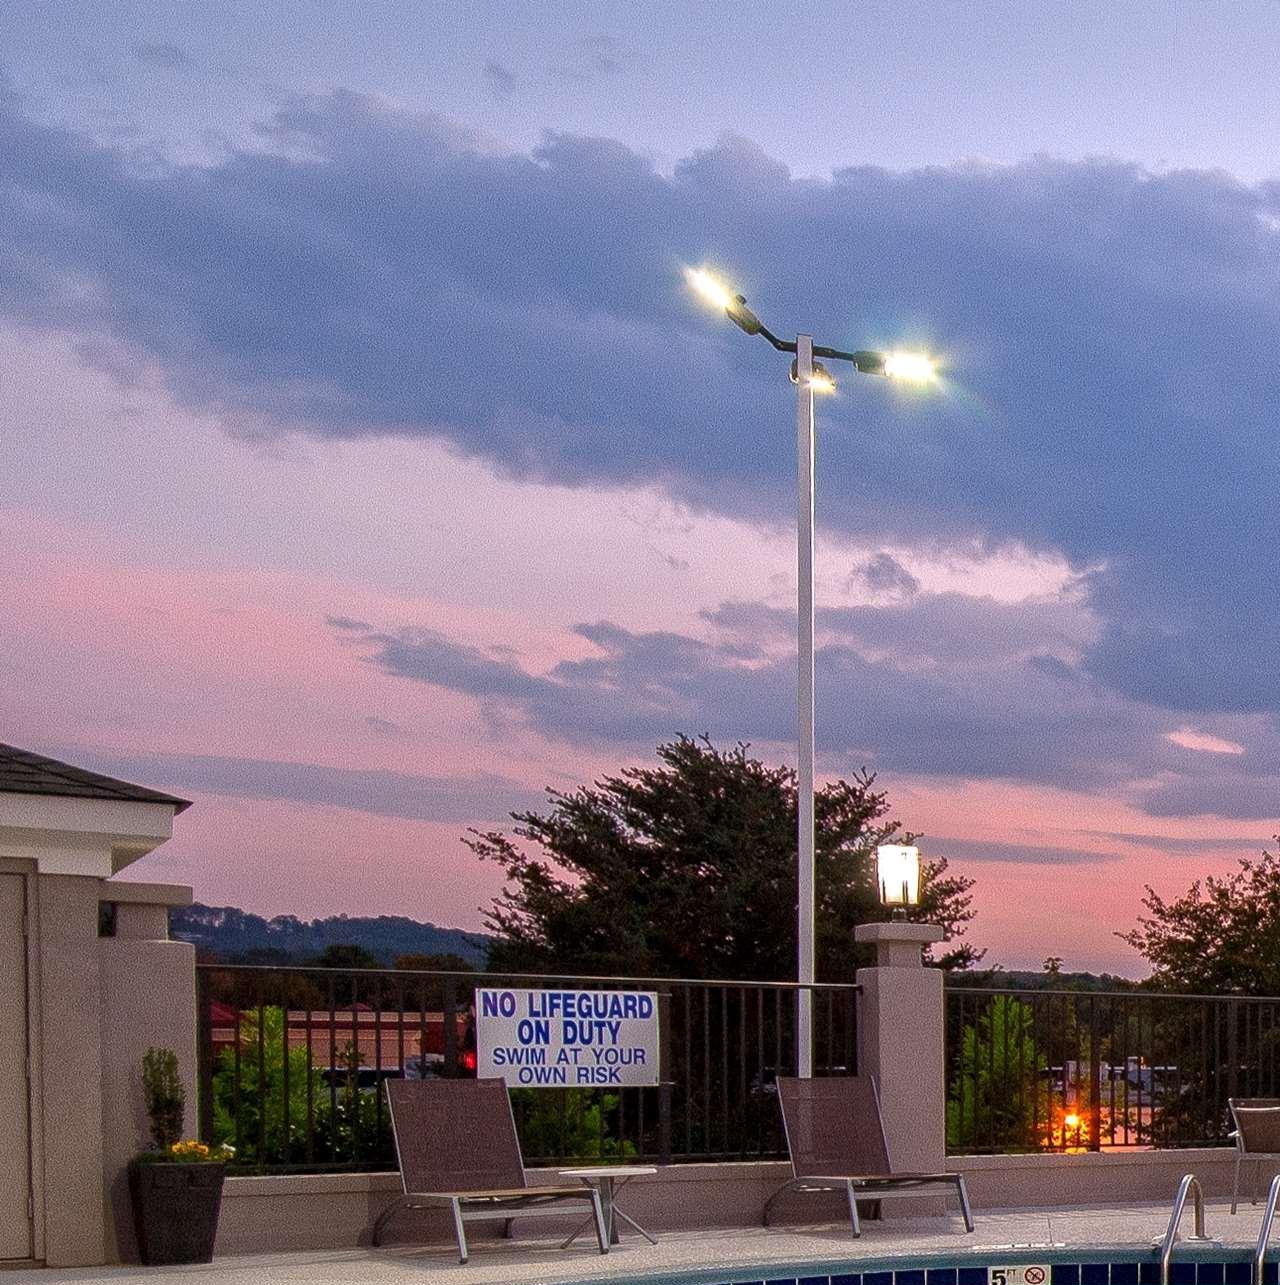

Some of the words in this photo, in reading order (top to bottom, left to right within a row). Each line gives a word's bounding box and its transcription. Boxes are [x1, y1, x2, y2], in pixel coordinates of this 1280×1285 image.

[482, 992, 517, 1018] NO
[528, 993, 653, 1019] LIFEGUARD
[517, 1019, 550, 1045] ON
[563, 1020, 622, 1045] DUTY
[492, 1047, 546, 1065] SWIM
[556, 1049, 582, 1065] AT
[592, 1049, 646, 1065] YOUR
[518, 1066, 566, 1084] OWN
[577, 1067, 621, 1084] RISK
